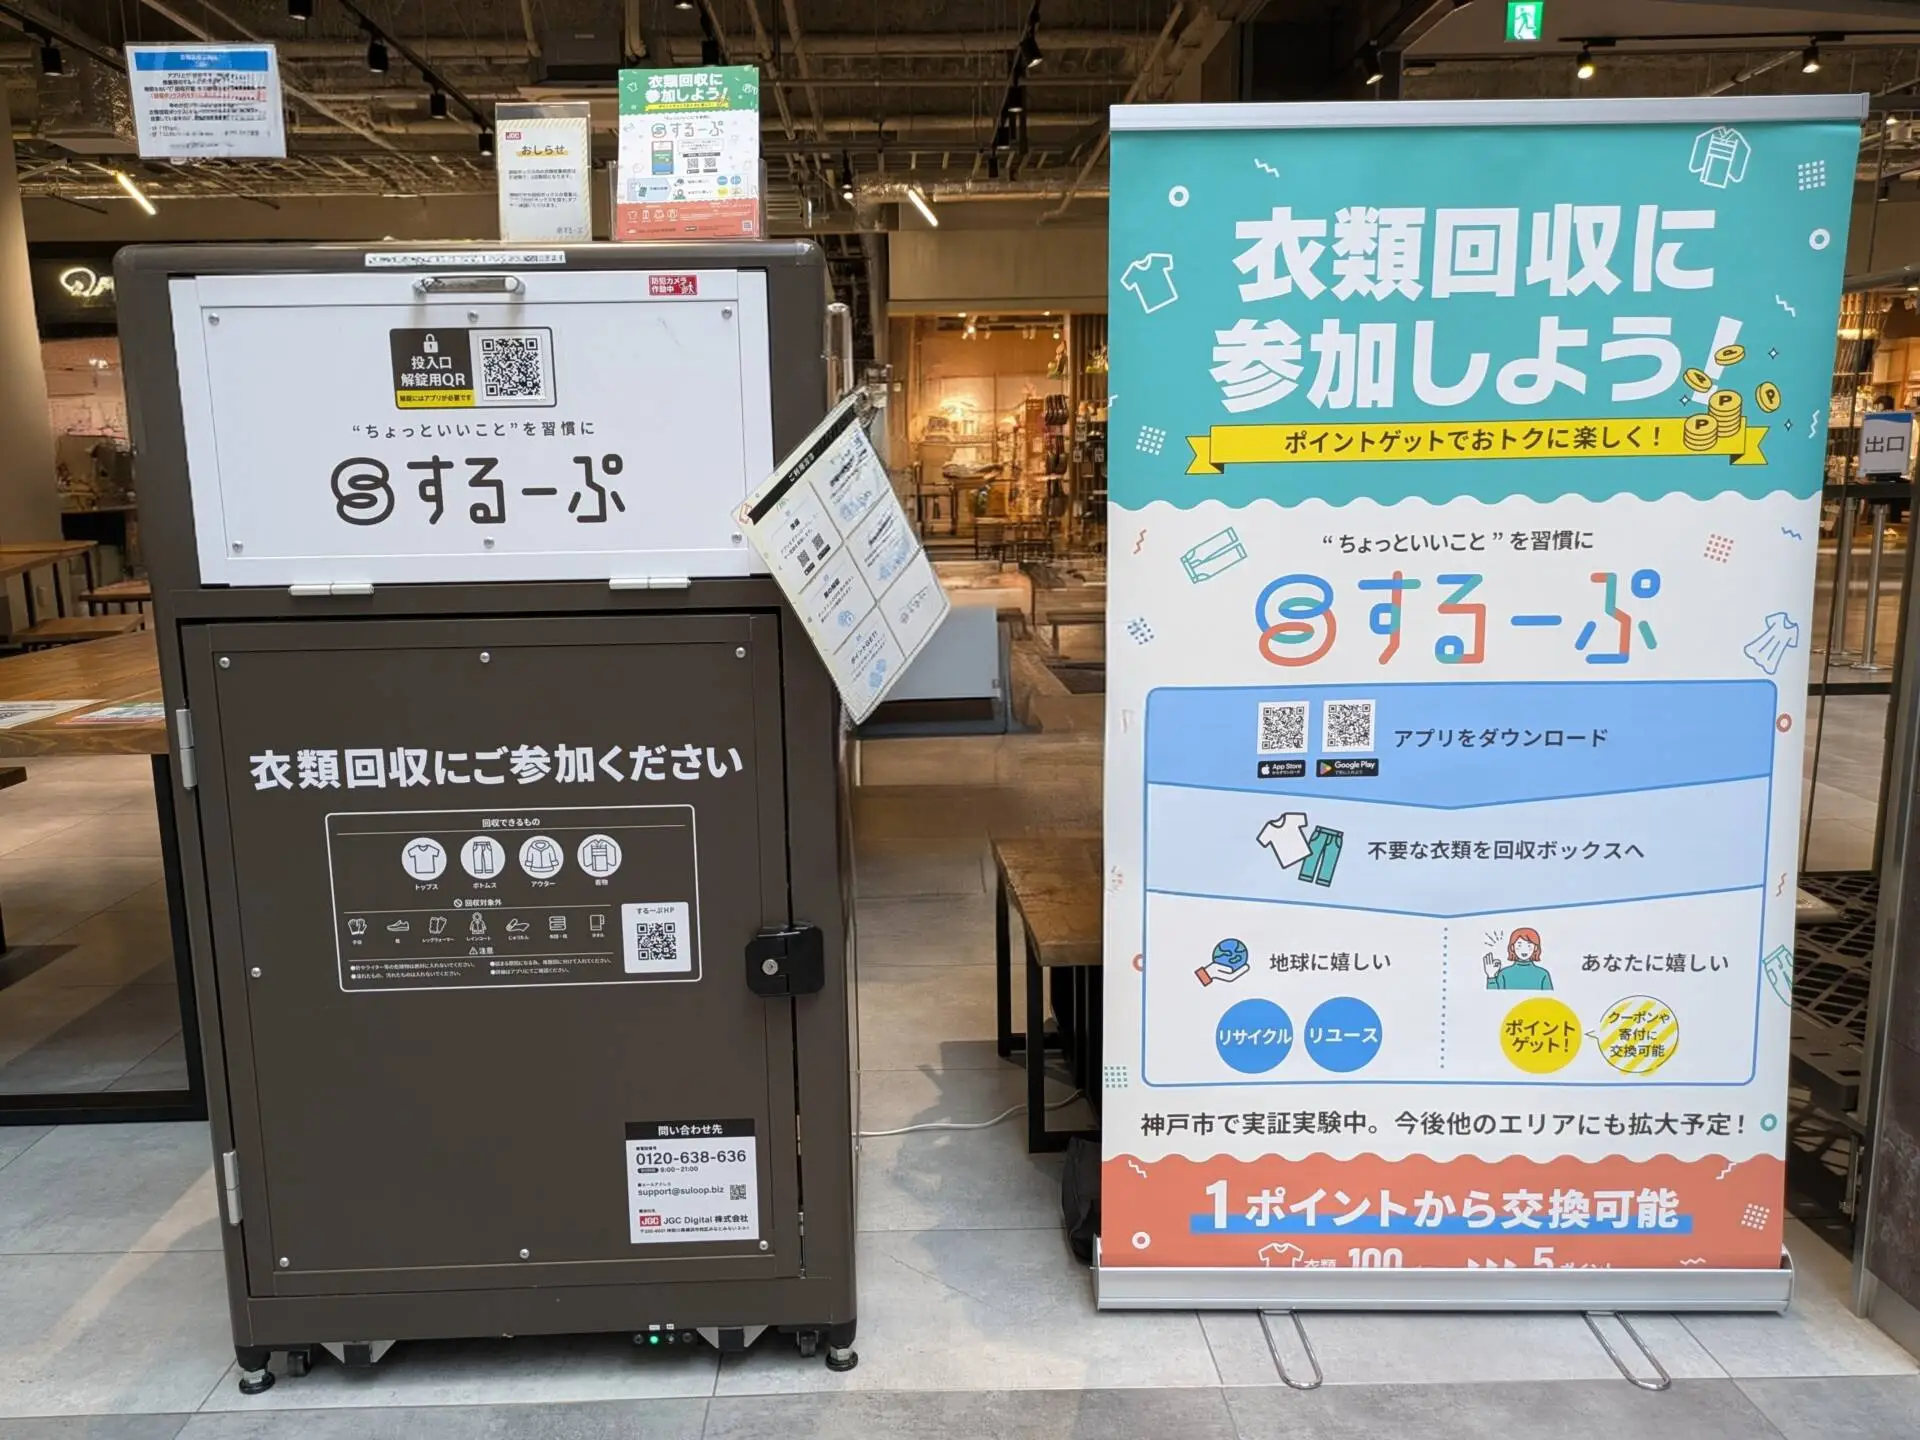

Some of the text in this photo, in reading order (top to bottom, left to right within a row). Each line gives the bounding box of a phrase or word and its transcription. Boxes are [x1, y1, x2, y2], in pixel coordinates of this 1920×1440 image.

[521, 145, 565, 155] おしらせ
[1233, 203, 1715, 303] 衣類回収に
[411, 356, 452, 370] 投入口
[1209, 316, 1743, 414] 参加しよう！
[401, 373, 466, 387] 解錠用QR
[1285, 424, 1662, 456] ポイントゲットでおトクに楽しく！
[1865, 435, 1905, 454] 出口
[406, 453, 626, 526] するーぷ
[1358, 569, 1661, 665] するーぷ
[1395, 727, 1609, 749] アプリをダウンロード
[249, 743, 744, 791] 衣類回収にご参加ください
[1334, 760, 1375, 770] Google Play
[482, 817, 541, 828] 回収できるもの
[1367, 838, 1645, 861] 不要な衣類を回収ボックスへ
[415, 883, 439, 891] トップス
[531, 880, 556, 888] アウター
[464, 898, 503, 907] 回収対象外
[479, 947, 494, 955] 注意
[1269, 951, 1391, 973] 地球に嬉しい
[1581, 952, 1730, 974] あなたに嬉しい
[1607, 1010, 1671, 1025] クーポンや
[1219, 1027, 1293, 1047] リサイクル
[1309, 1025, 1379, 1045] リユース
[1506, 1019, 1576, 1038] ポイント
[1619, 1027, 1658, 1043] 寄付に
[1512, 1035, 1570, 1054] ゲット！
[1610, 1043, 1666, 1059] 交換可能
[658, 1124, 723, 1137] 問い合わせ先
[1141, 1110, 1747, 1137] 神戸市で実証実験中。今後他のエリアにも拡大予定！
[636, 1150, 746, 1165] 0120-638-636
[638, 1186, 724, 1197] support@suloop.biz
[1205, 1178, 1679, 1229] 1ポイントから交換可能
[641, 1216, 660, 1226] JGC
[664, 1213, 749, 1226] JGC Digital 株式会社
[1348, 1247, 1403, 1268] 100
[1533, 1246, 1555, 1268] 5
